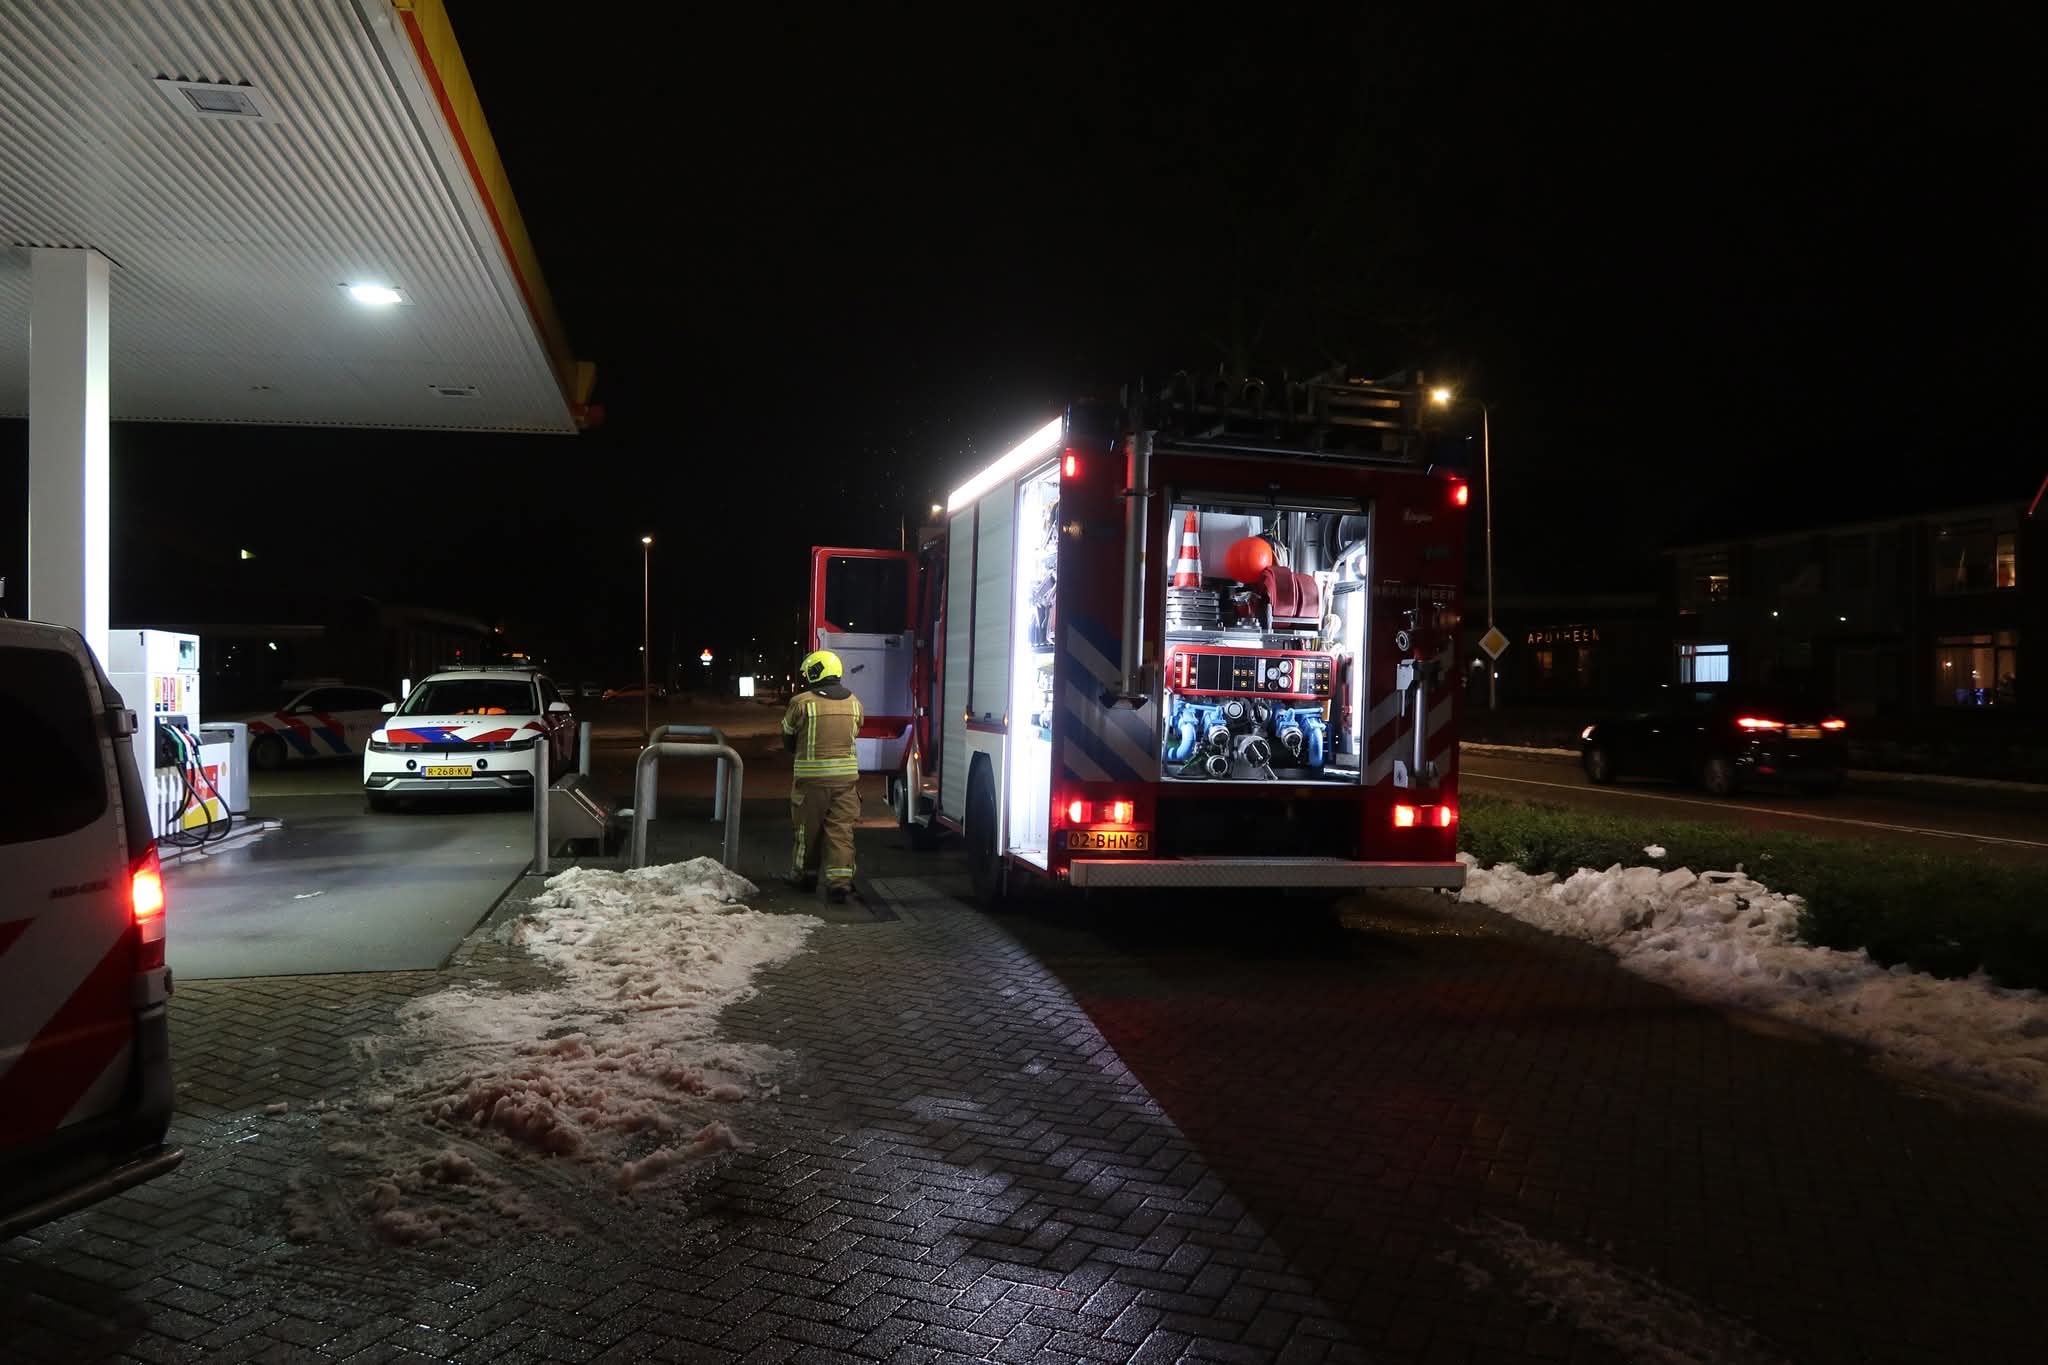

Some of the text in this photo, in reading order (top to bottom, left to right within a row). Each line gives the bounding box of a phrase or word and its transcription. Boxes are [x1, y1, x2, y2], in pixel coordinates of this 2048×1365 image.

[139, 631, 144, 646] 1
[427, 767, 470, 776] R-268-KV
[1070, 833, 1145, 849] 02-BHN-8
